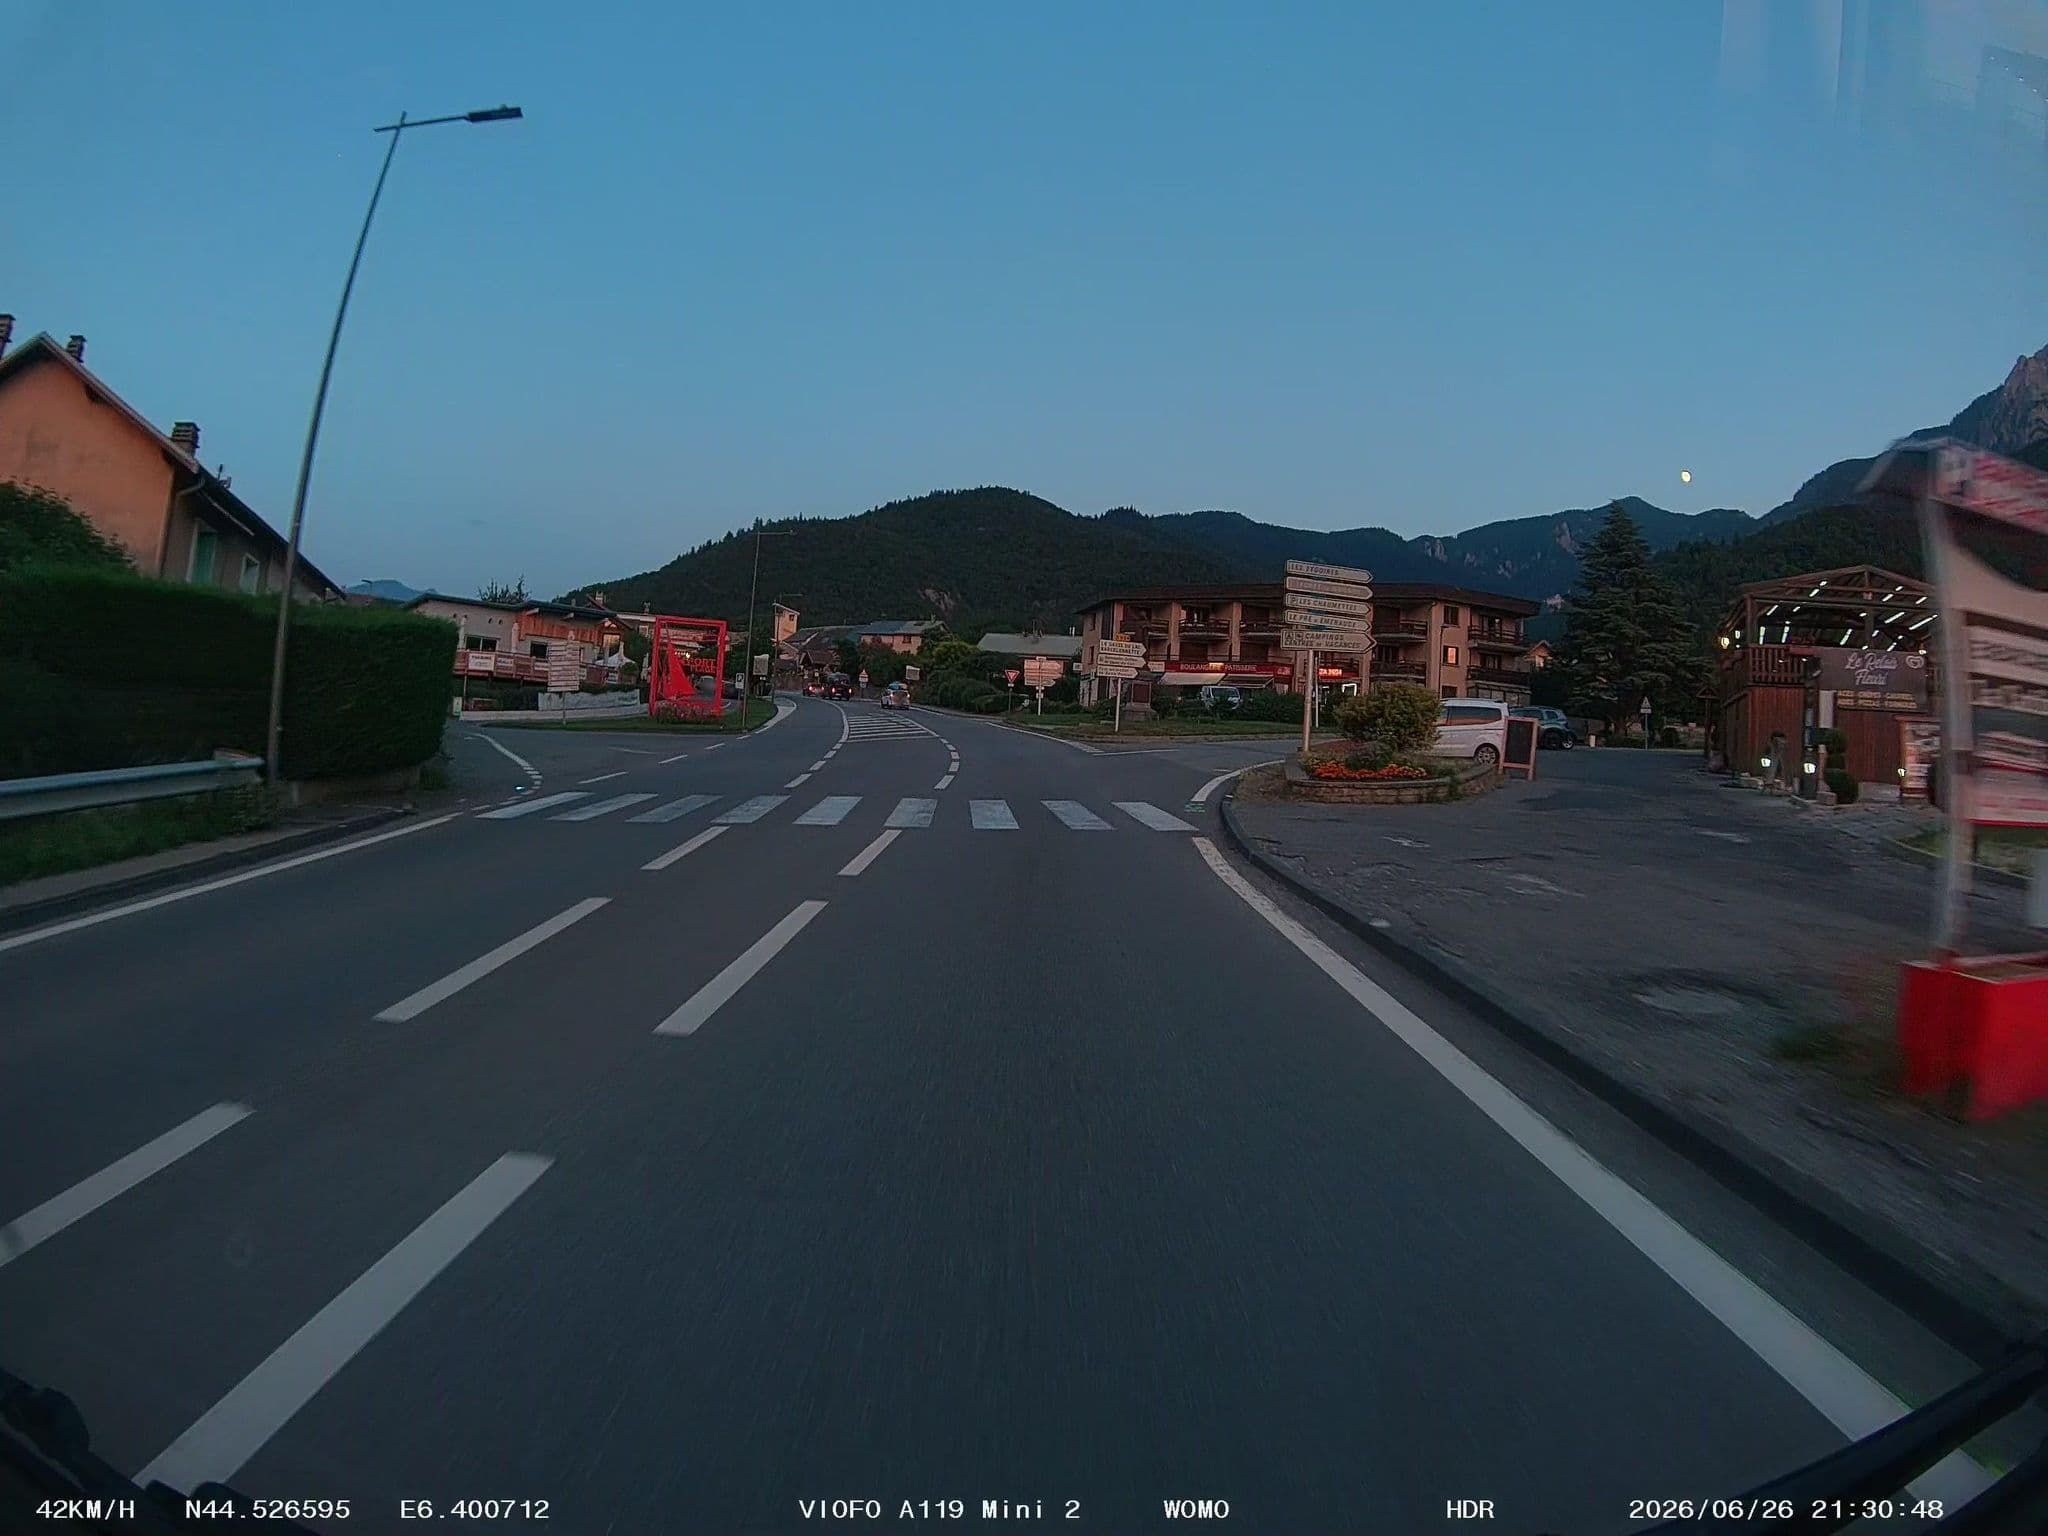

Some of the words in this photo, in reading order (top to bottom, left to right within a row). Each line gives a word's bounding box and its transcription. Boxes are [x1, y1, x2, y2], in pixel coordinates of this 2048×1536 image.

[1291, 563, 1303, 571] LES
[1299, 598, 1312, 606] LES
[1305, 633, 1345, 641] CAMPINGS
[1284, 639, 1314, 647] CENTRES
[1844, 652, 1861, 670] Le
[1180, 661, 1221, 671] BOULANGERIE
